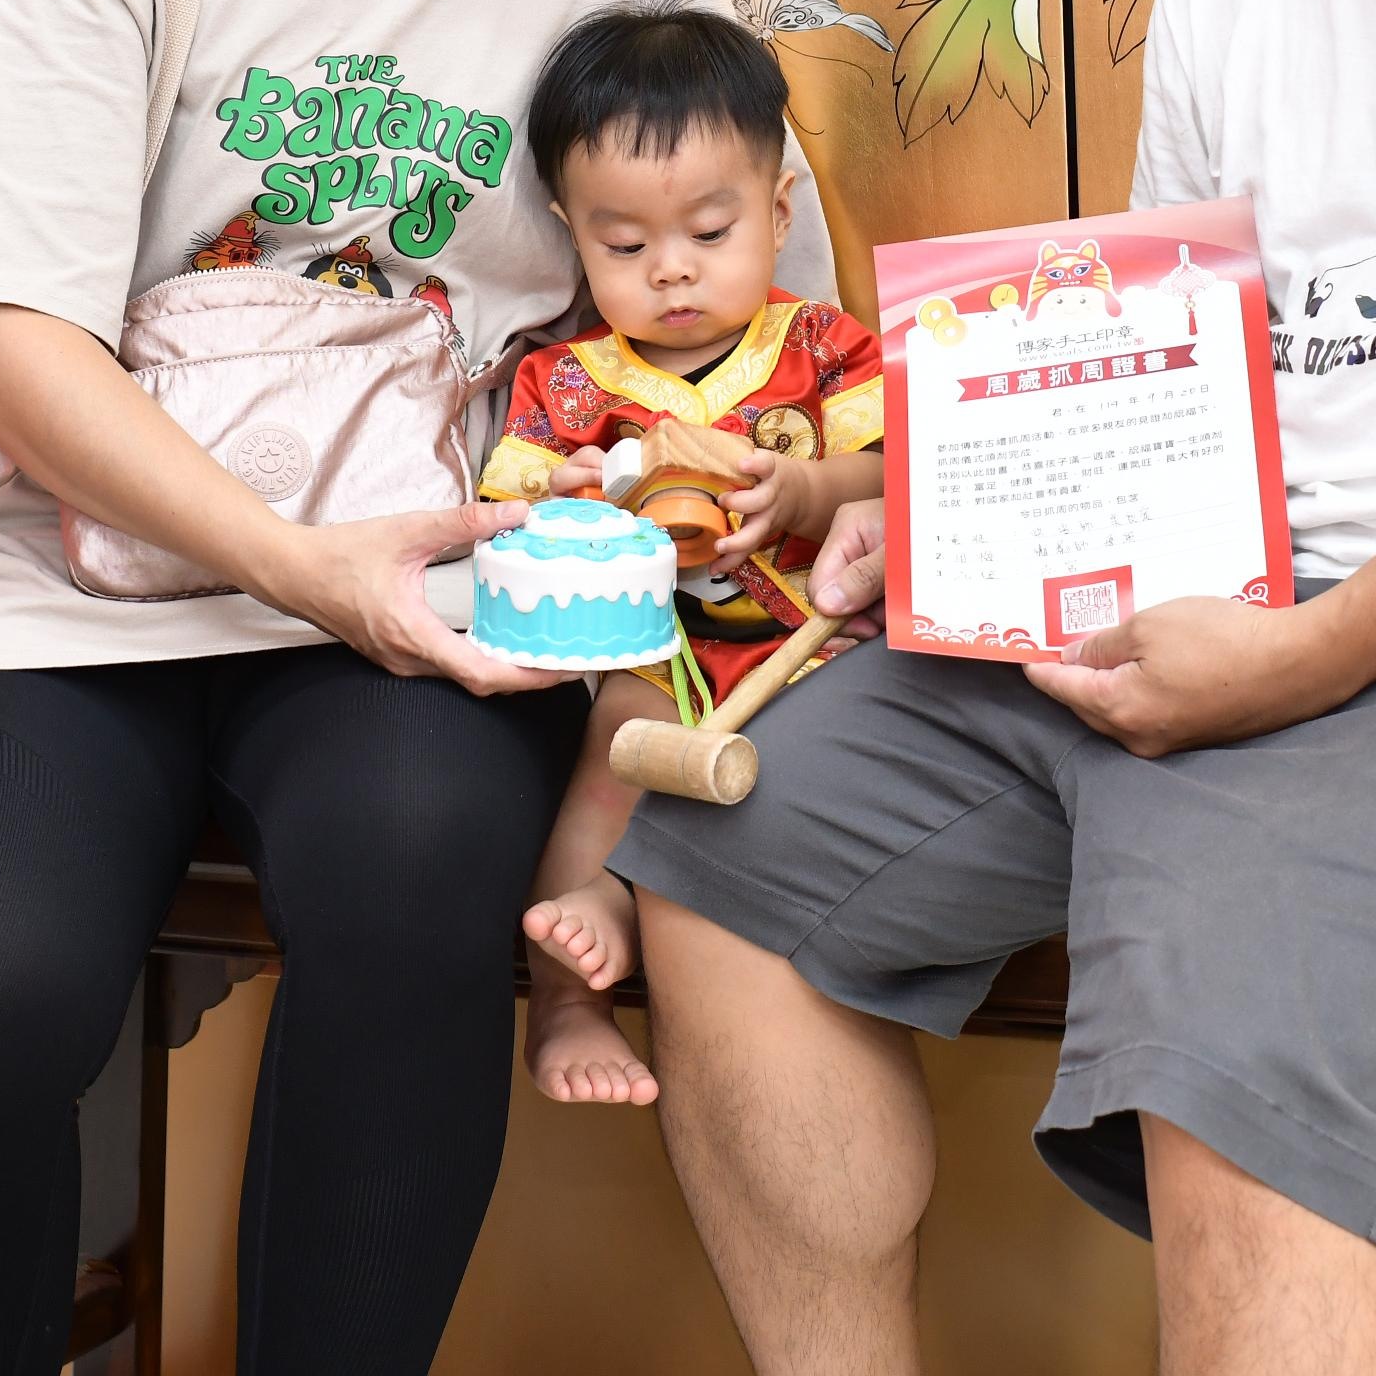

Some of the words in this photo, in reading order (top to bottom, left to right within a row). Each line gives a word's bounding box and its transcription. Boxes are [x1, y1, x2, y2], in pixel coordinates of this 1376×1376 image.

[315, 54, 405, 87] THE
[252, 154, 474, 259] SPLITS
[1015, 325, 1135, 355] 傳家手工印章
[1018, 340, 1132, 363] www.seals.com.tw
[986, 351, 1169, 397] 周歲抓周證書
